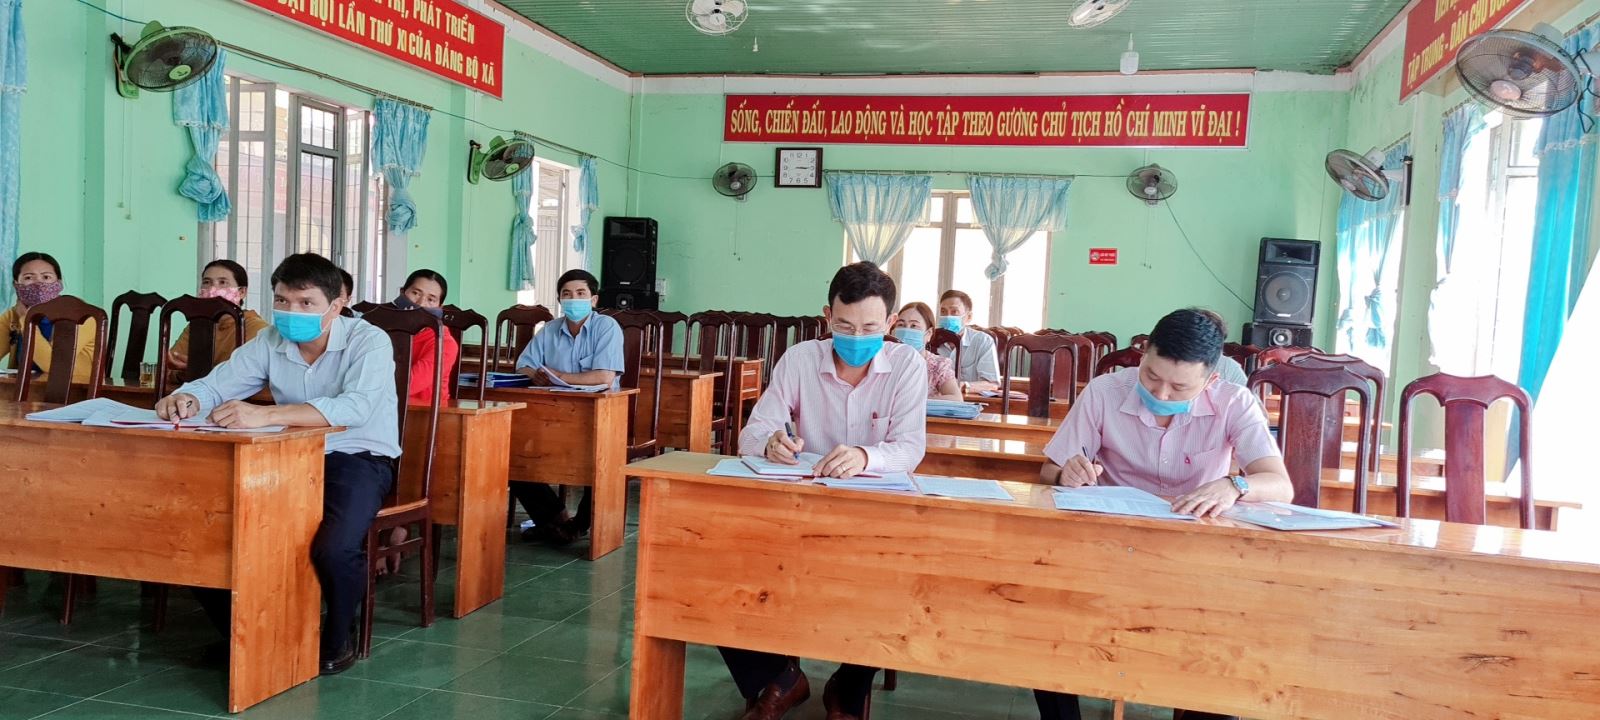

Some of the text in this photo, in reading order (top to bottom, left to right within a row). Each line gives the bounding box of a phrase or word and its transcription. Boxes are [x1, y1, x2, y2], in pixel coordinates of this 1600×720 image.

[338, 1, 366, 36] LẦN
[370, 16, 394, 46] THỨ
[397, 28, 407, 52] XI
[408, 30, 431, 62] CỦA
[435, 41, 463, 74] ĐẢNG
[466, 56, 478, 84] BỘ
[482, 62, 495, 86] XÃ
[413, 0, 441, 29] PHÁT
[445, 12, 475, 44] TRIỂN
[731, 99, 762, 136] SỐNG,
[765, 99, 800, 133] CHIẾN
[802, 99, 828, 137] ĐẤU,
[831, 110, 852, 135] LAO
[855, 104, 887, 140] ĐỘNG
[889, 103, 905, 135] VÀ
[908, 110, 933, 142] HỌC
[936, 104, 959, 142] TẬP
[962, 110, 994, 136] THEO
[997, 106, 1038, 137] GƯƠNG
[1041, 101, 1067, 137] CHỦ
[1071, 111, 1101, 143] TỊCH
[1103, 98, 1124, 137] HỒ
[1126, 103, 1150, 137] CHÍ
[1152, 110, 1188, 137] MINH
[1191, 104, 1206, 136] VĨ
[1207, 110, 1233, 143] ĐẠI
